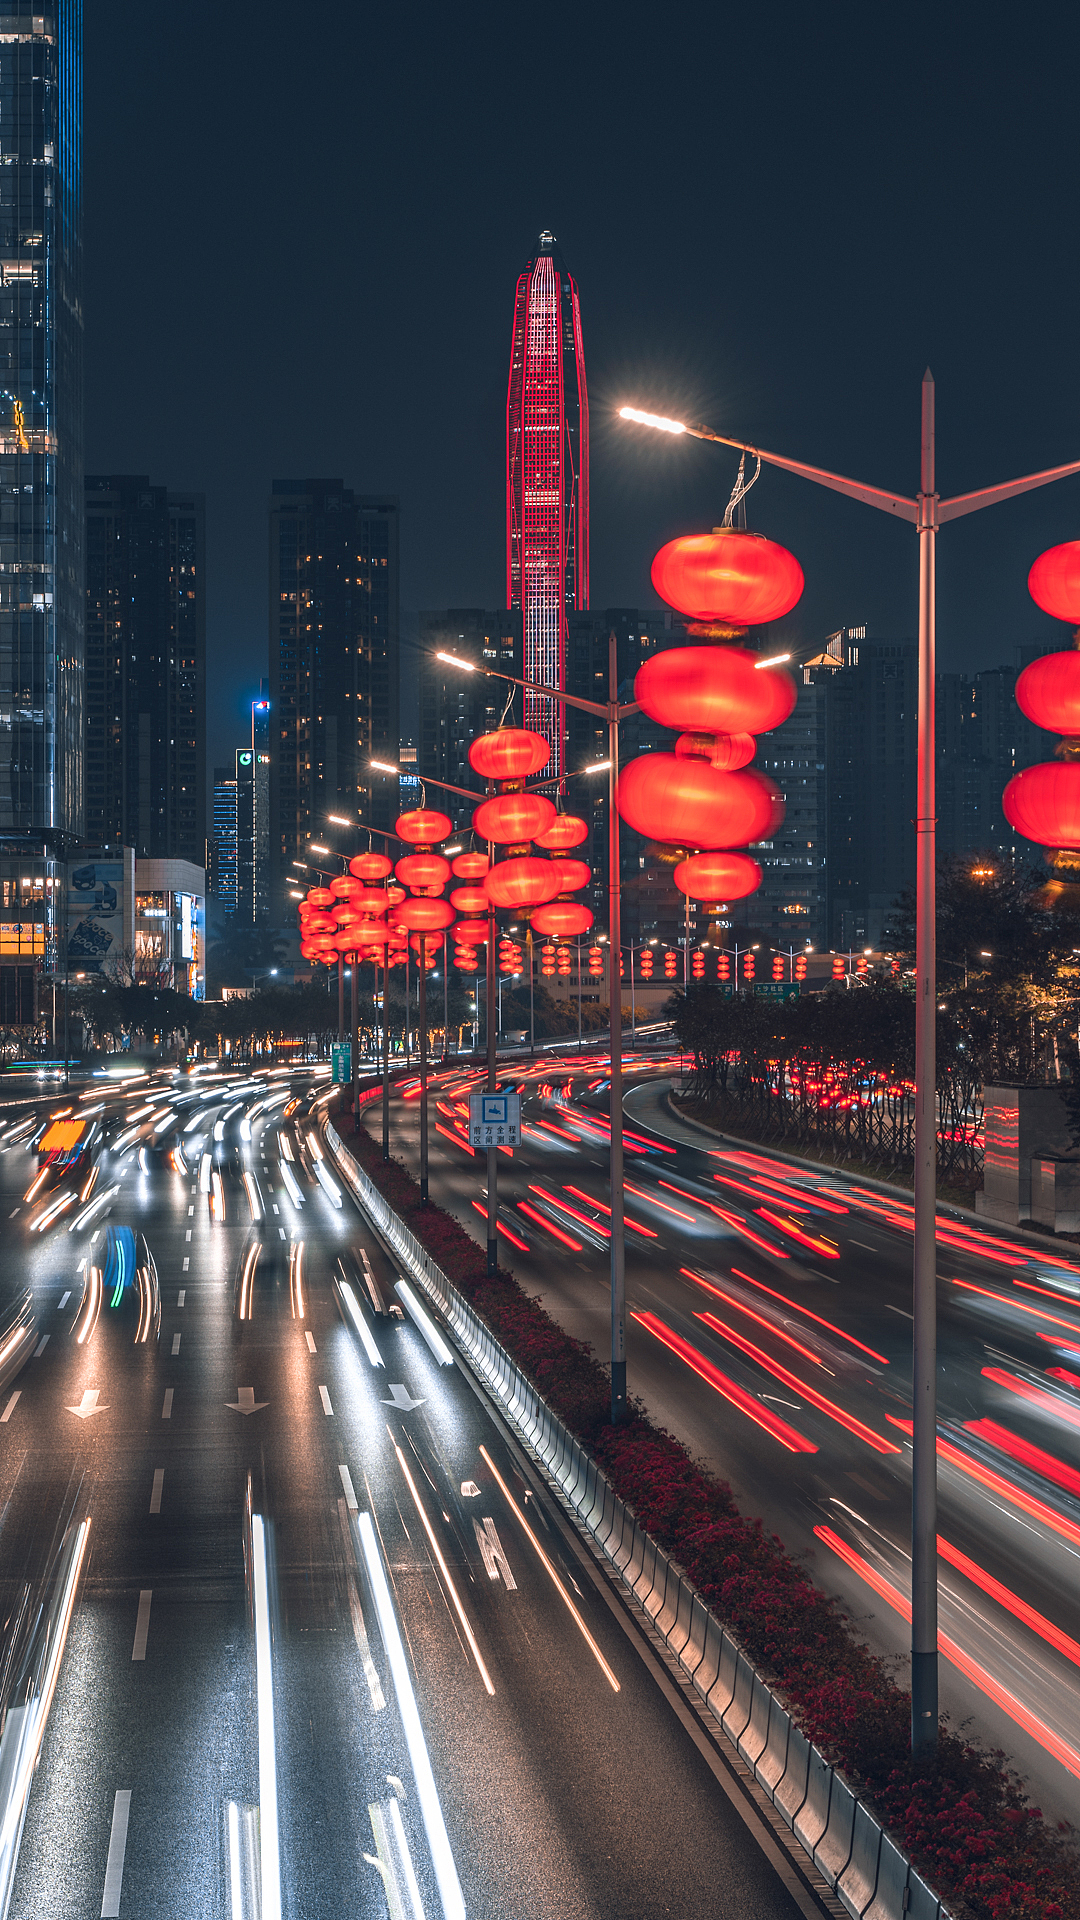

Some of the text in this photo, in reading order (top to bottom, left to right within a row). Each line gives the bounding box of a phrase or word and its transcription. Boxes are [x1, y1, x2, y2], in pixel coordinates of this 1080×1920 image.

[80, 919, 114, 941] space
[73, 934, 106, 956] space
[473, 1126, 516, 1135] 前方全程
[473, 1136, 516, 1144] 区间测速
